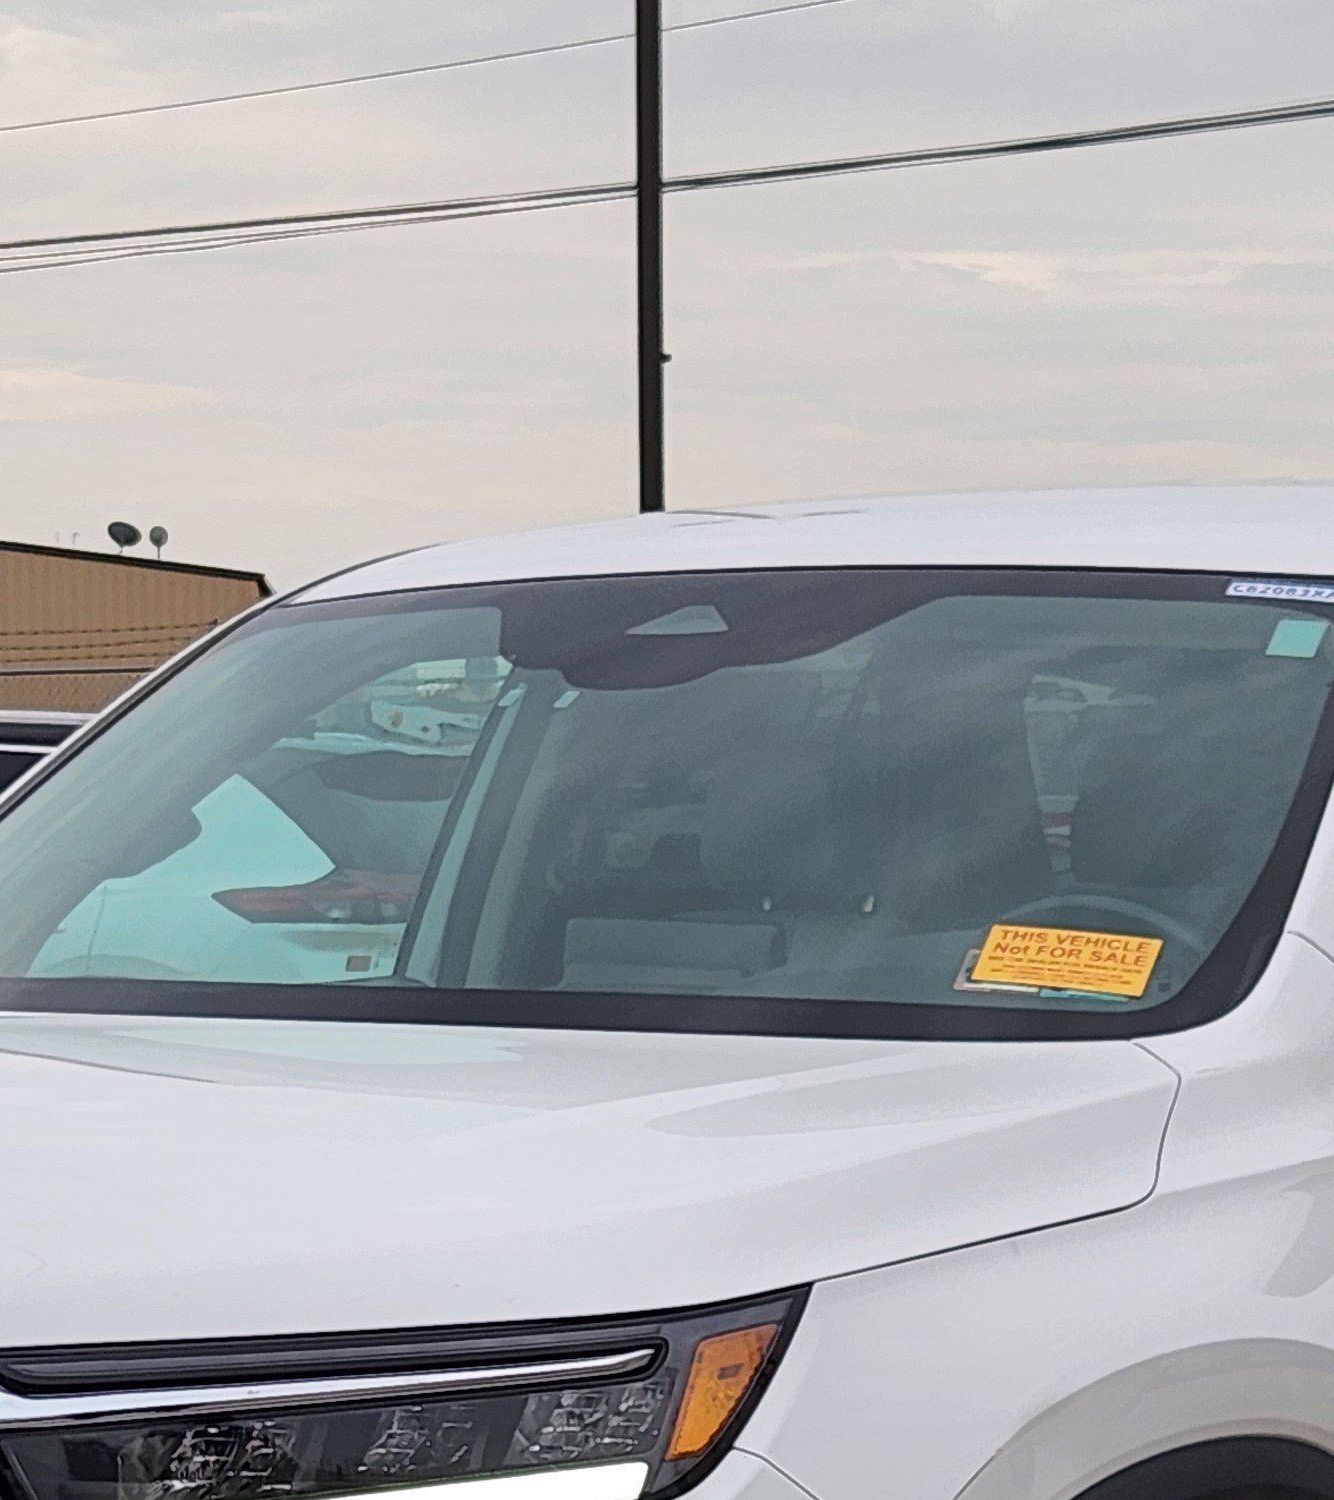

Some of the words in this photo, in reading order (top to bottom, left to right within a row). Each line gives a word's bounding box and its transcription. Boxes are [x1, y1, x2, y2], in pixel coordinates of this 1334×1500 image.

[1001, 929, 1049, 943] THIS
[1056, 934, 1152, 953] VEHICLE
[992, 942, 1030, 955] Not
[1035, 945, 1083, 959] FOR
[1088, 950, 1147, 967] SALE
